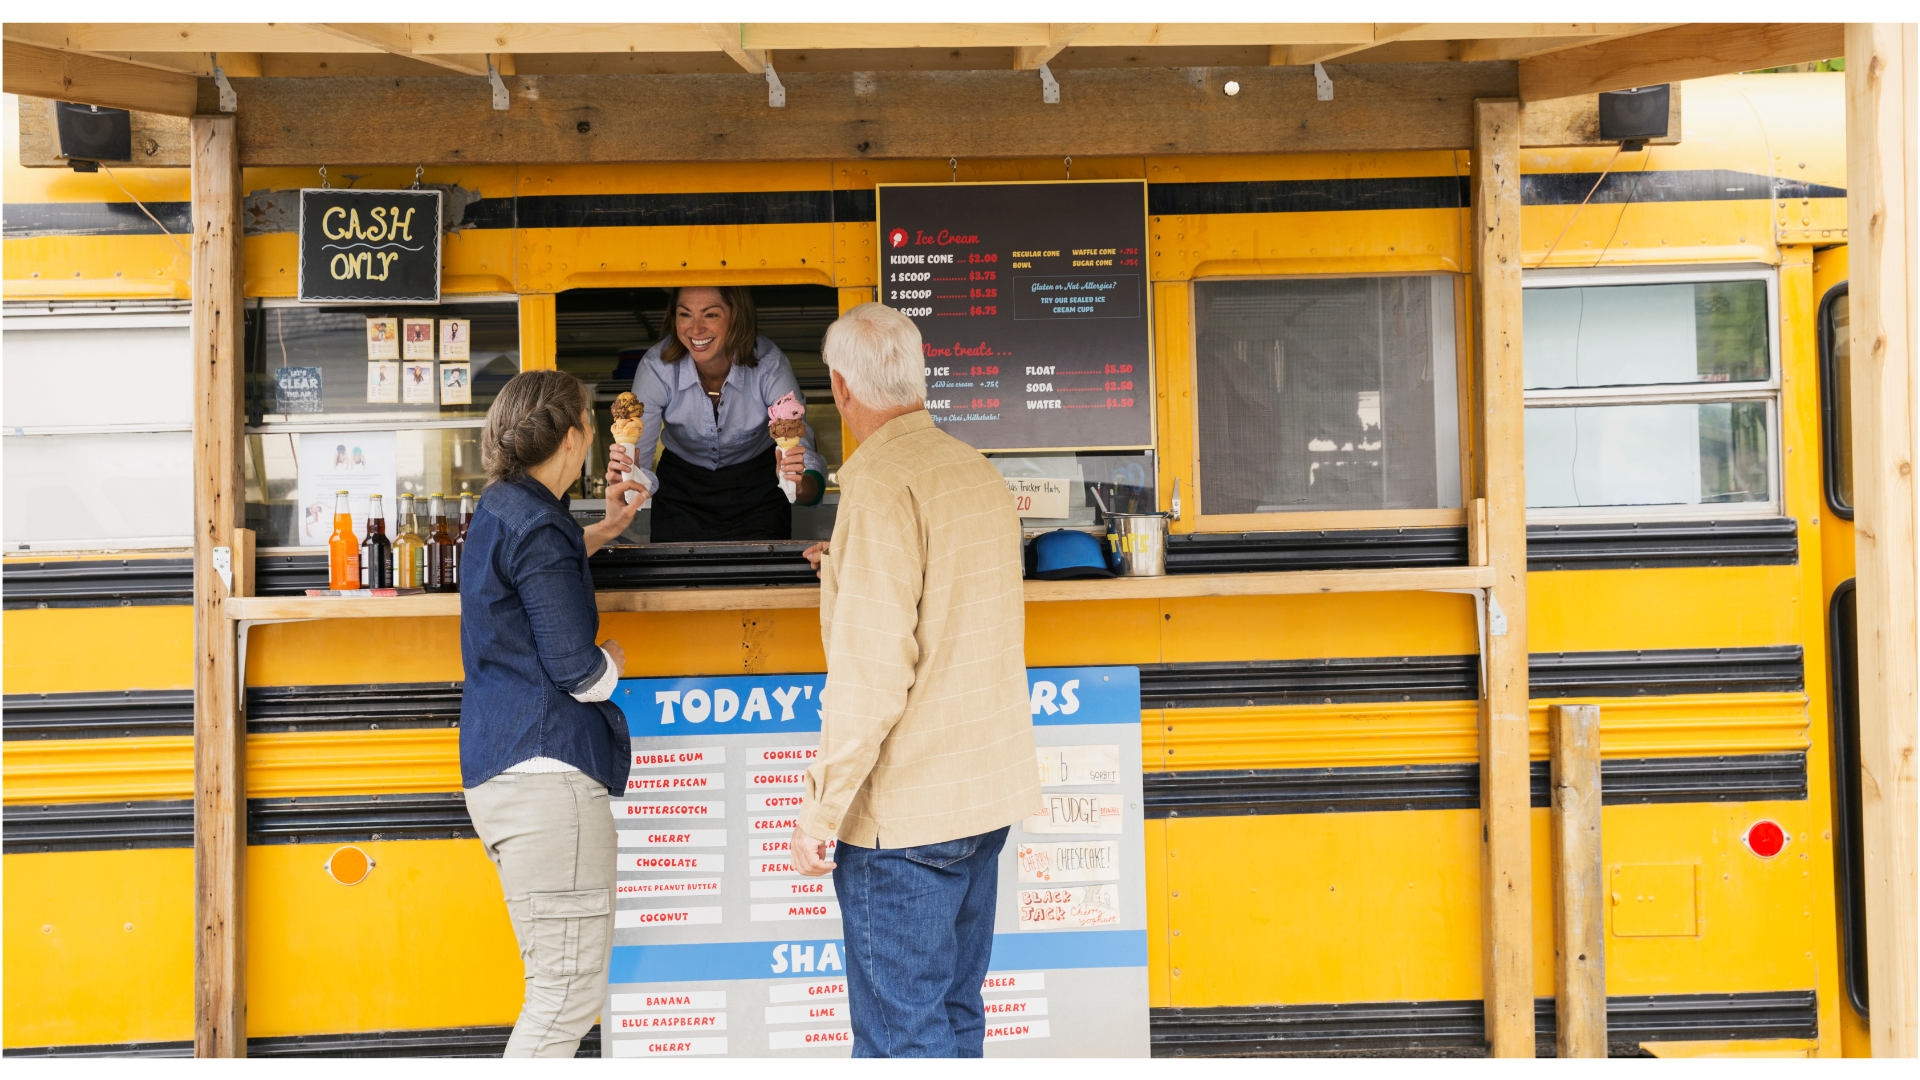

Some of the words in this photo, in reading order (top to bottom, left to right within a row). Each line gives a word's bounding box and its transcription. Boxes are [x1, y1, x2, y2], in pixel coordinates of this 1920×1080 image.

[322, 206, 416, 241] CASH
[914, 230, 936, 245] Ice
[937, 229, 980, 246] Cream
[1072, 248, 1098, 256] WAFFLE
[890, 255, 925, 265] KIDDIE
[927, 254, 954, 264] CONE
[968, 252, 998, 265] $2.00
[330, 251, 399, 281] ONLY
[890, 273, 897, 282] 1
[898, 272, 931, 282] SCOOP
[969, 270, 996, 282] $3.75
[1031, 282, 1054, 292] Gluten
[1064, 282, 1079, 291] Nut
[1080, 281, 1117, 291] Allergies?
[890, 290, 898, 300] 2
[899, 290, 932, 300] SCOOP
[970, 288, 998, 300] $5.25
[900, 307, 933, 317] SCOOP
[970, 305, 997, 317] $6.75
[921, 343, 952, 357] More
[952, 341, 994, 356] treats
[933, 366, 950, 377] ICE
[970, 365, 999, 377] $3.50
[1025, 366, 1056, 376] FLOAT
[1104, 363, 1133, 375] $5.50
[279, 378, 318, 389] CLEAR
[1025, 383, 1053, 393] SODA
[1104, 380, 1133, 392] $2.50
[971, 397, 1000, 410] $5.50
[1026, 399, 1062, 410] WATER
[1106, 397, 1134, 410] $1.50
[963, 413, 1000, 422] Milkshake!
[1017, 480, 1041, 492] Trucker
[1044, 482, 1061, 493] Hats
[1030, 679, 1080, 716] RS
[635, 753, 676, 765] BUBBLE
[678, 752, 704, 763] GUM
[763, 750, 802, 760] COOKIE
[1037, 752, 1084, 783] ainbow
[1089, 770, 1116, 781] SORBET
[628, 779, 670, 789] BUTTER
[673, 777, 707, 788] PECAN
[753, 774, 799, 784] COOKIES
[627, 805, 708, 815] BUTTERSCOTCH
[1050, 797, 1098, 823] FUDGE
[648, 834, 691, 843] CHERRY
[762, 842, 792, 851] ESPR
[636, 858, 698, 868] CHOCOLATE
[1022, 850, 1050, 872] CHERRY
[1056, 847, 1110, 871] CHEESECAKE!
[616, 884, 652, 893] OCOLATE
[654, 883, 685, 892] PEANUT
[687, 882, 718, 892] BUTTER
[791, 884, 824, 894] TIGER
[1022, 890, 1071, 905] BLACK
[788, 906, 827, 916] MANGO
[1021, 906, 1066, 922] JACK
[1070, 905, 1106, 919] Cherry
[640, 912, 689, 923] COCONUT
[770, 943, 846, 974] SHA
[983, 978, 1016, 988] TBEER
[808, 984, 844, 995] GRAPE
[646, 996, 691, 1006] BANANA
[809, 1008, 835, 1018] LIME
[984, 1003, 1027, 1014] WBERRY
[622, 1018, 649, 1028] BLUE
[652, 1016, 716, 1027] RASPBERRY
[805, 1032, 849, 1043] ORANGE
[986, 1026, 1030, 1038] RMELON
[648, 1043, 692, 1052] CHERRY
